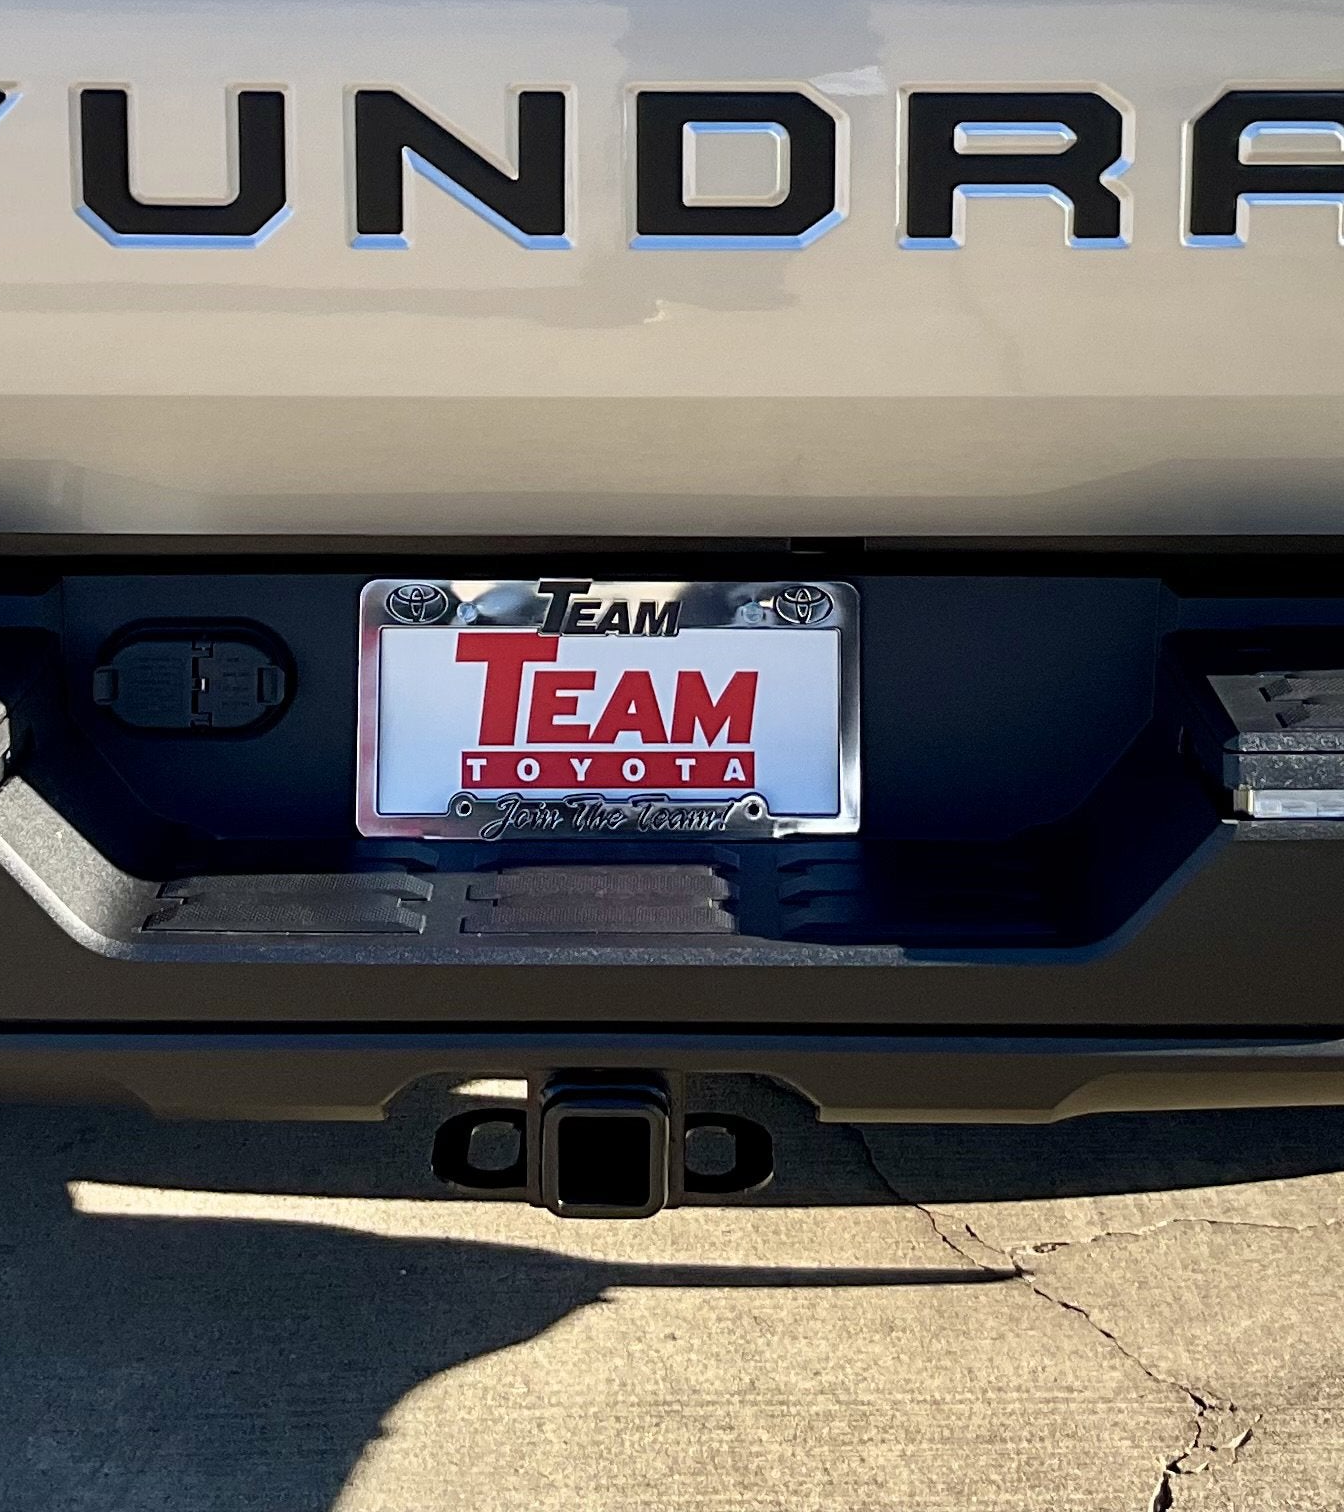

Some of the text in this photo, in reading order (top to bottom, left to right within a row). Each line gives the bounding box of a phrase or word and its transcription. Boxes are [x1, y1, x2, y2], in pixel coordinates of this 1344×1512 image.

[536, 578, 681, 638] TEAM
[456, 632, 758, 748] TEAM
[466, 756, 747, 783] TOYOTA
[479, 793, 736, 840] Join The Team!
